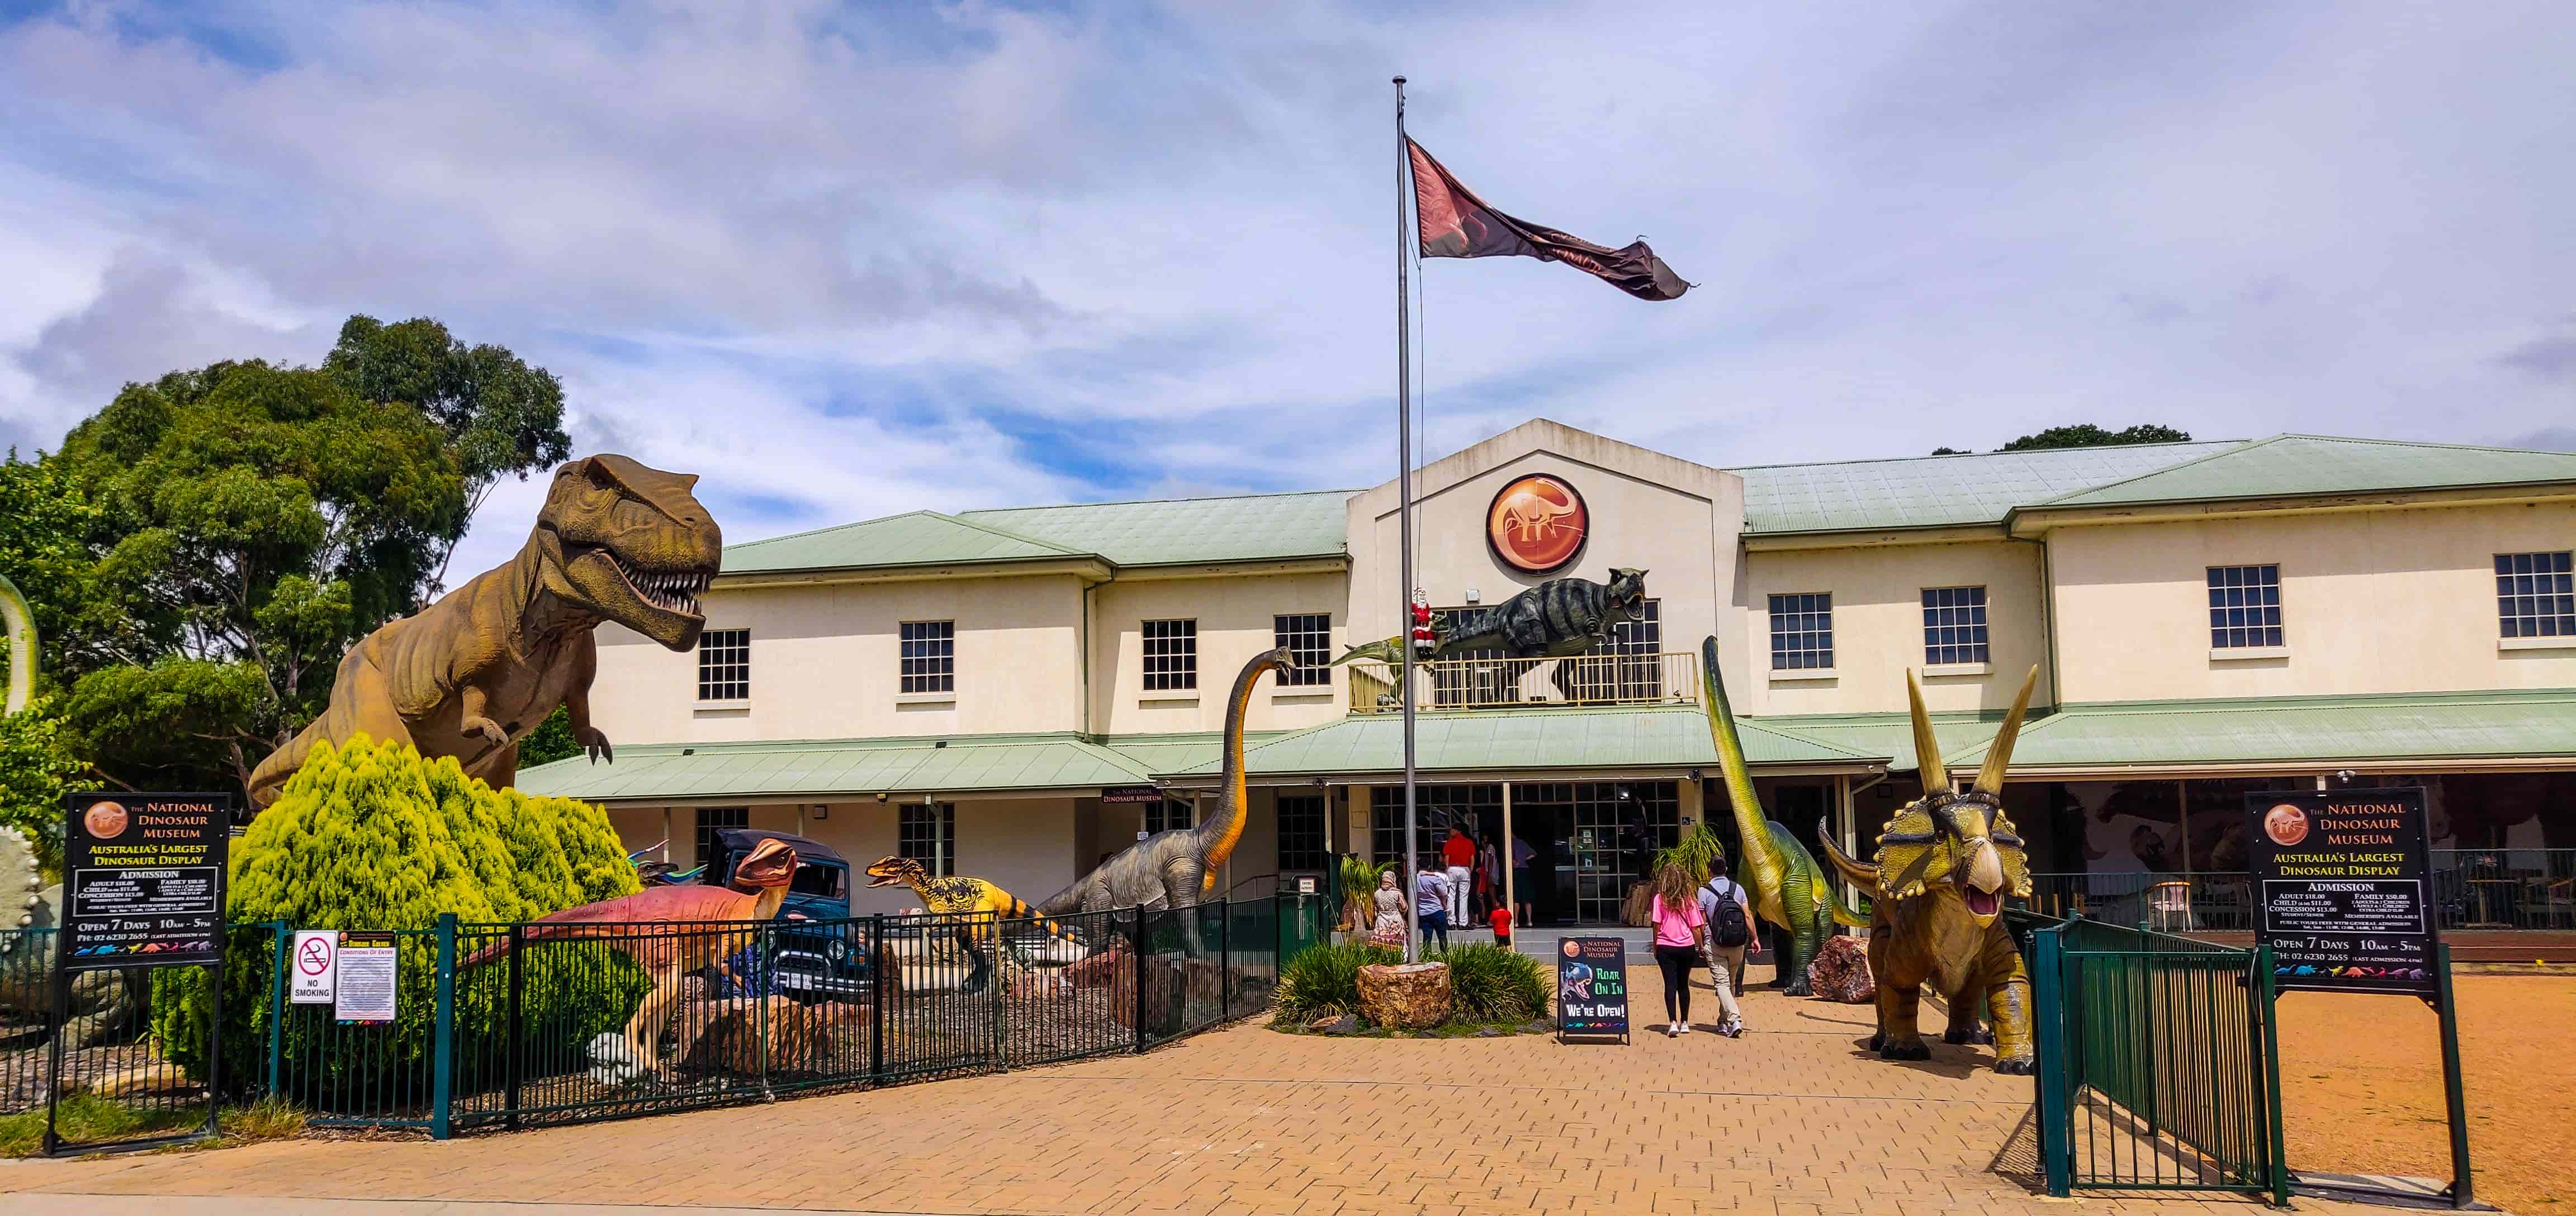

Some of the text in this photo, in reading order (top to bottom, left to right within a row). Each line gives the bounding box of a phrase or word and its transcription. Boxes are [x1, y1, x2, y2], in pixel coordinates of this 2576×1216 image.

[148, 802, 215, 812] NATIONAL
[2328, 804, 2406, 814] NATIONAL
[139, 815, 208, 825] DINOSAUR
[2321, 819, 2401, 830] DINOSAUR
[144, 829, 200, 838] MUSEUM
[2328, 835, 2393, 845] MUSEUM
[89, 844, 209, 854] AUSTRALIA'S LARGEST
[94, 856, 205, 866] DINOSAUR DISPLAY
[2273, 852, 2404, 863] AUSTRALIA'S LARGEST
[2280, 866, 2400, 876] DINOSAUR DISPLAY
[2308, 882, 2375, 891] ADMISSION
[78, 923, 108, 931] OPEN
[111, 919, 122, 930] 7
[124, 922, 151, 930] DAYS
[2274, 939, 2303, 948] OPEN
[2307, 937, 2317, 948] 7
[2321, 940, 2349, 949] DAYS
[2359, 939, 2388, 950] 10AM
[2400, 940, 2421, 951] 5PM
[1596, 968, 1620, 980] ROAR
[307, 979, 318, 987] NO
[1595, 982, 1623, 995] ON IN
[1566, 1004, 1625, 1018] WE'RE OPEN!
